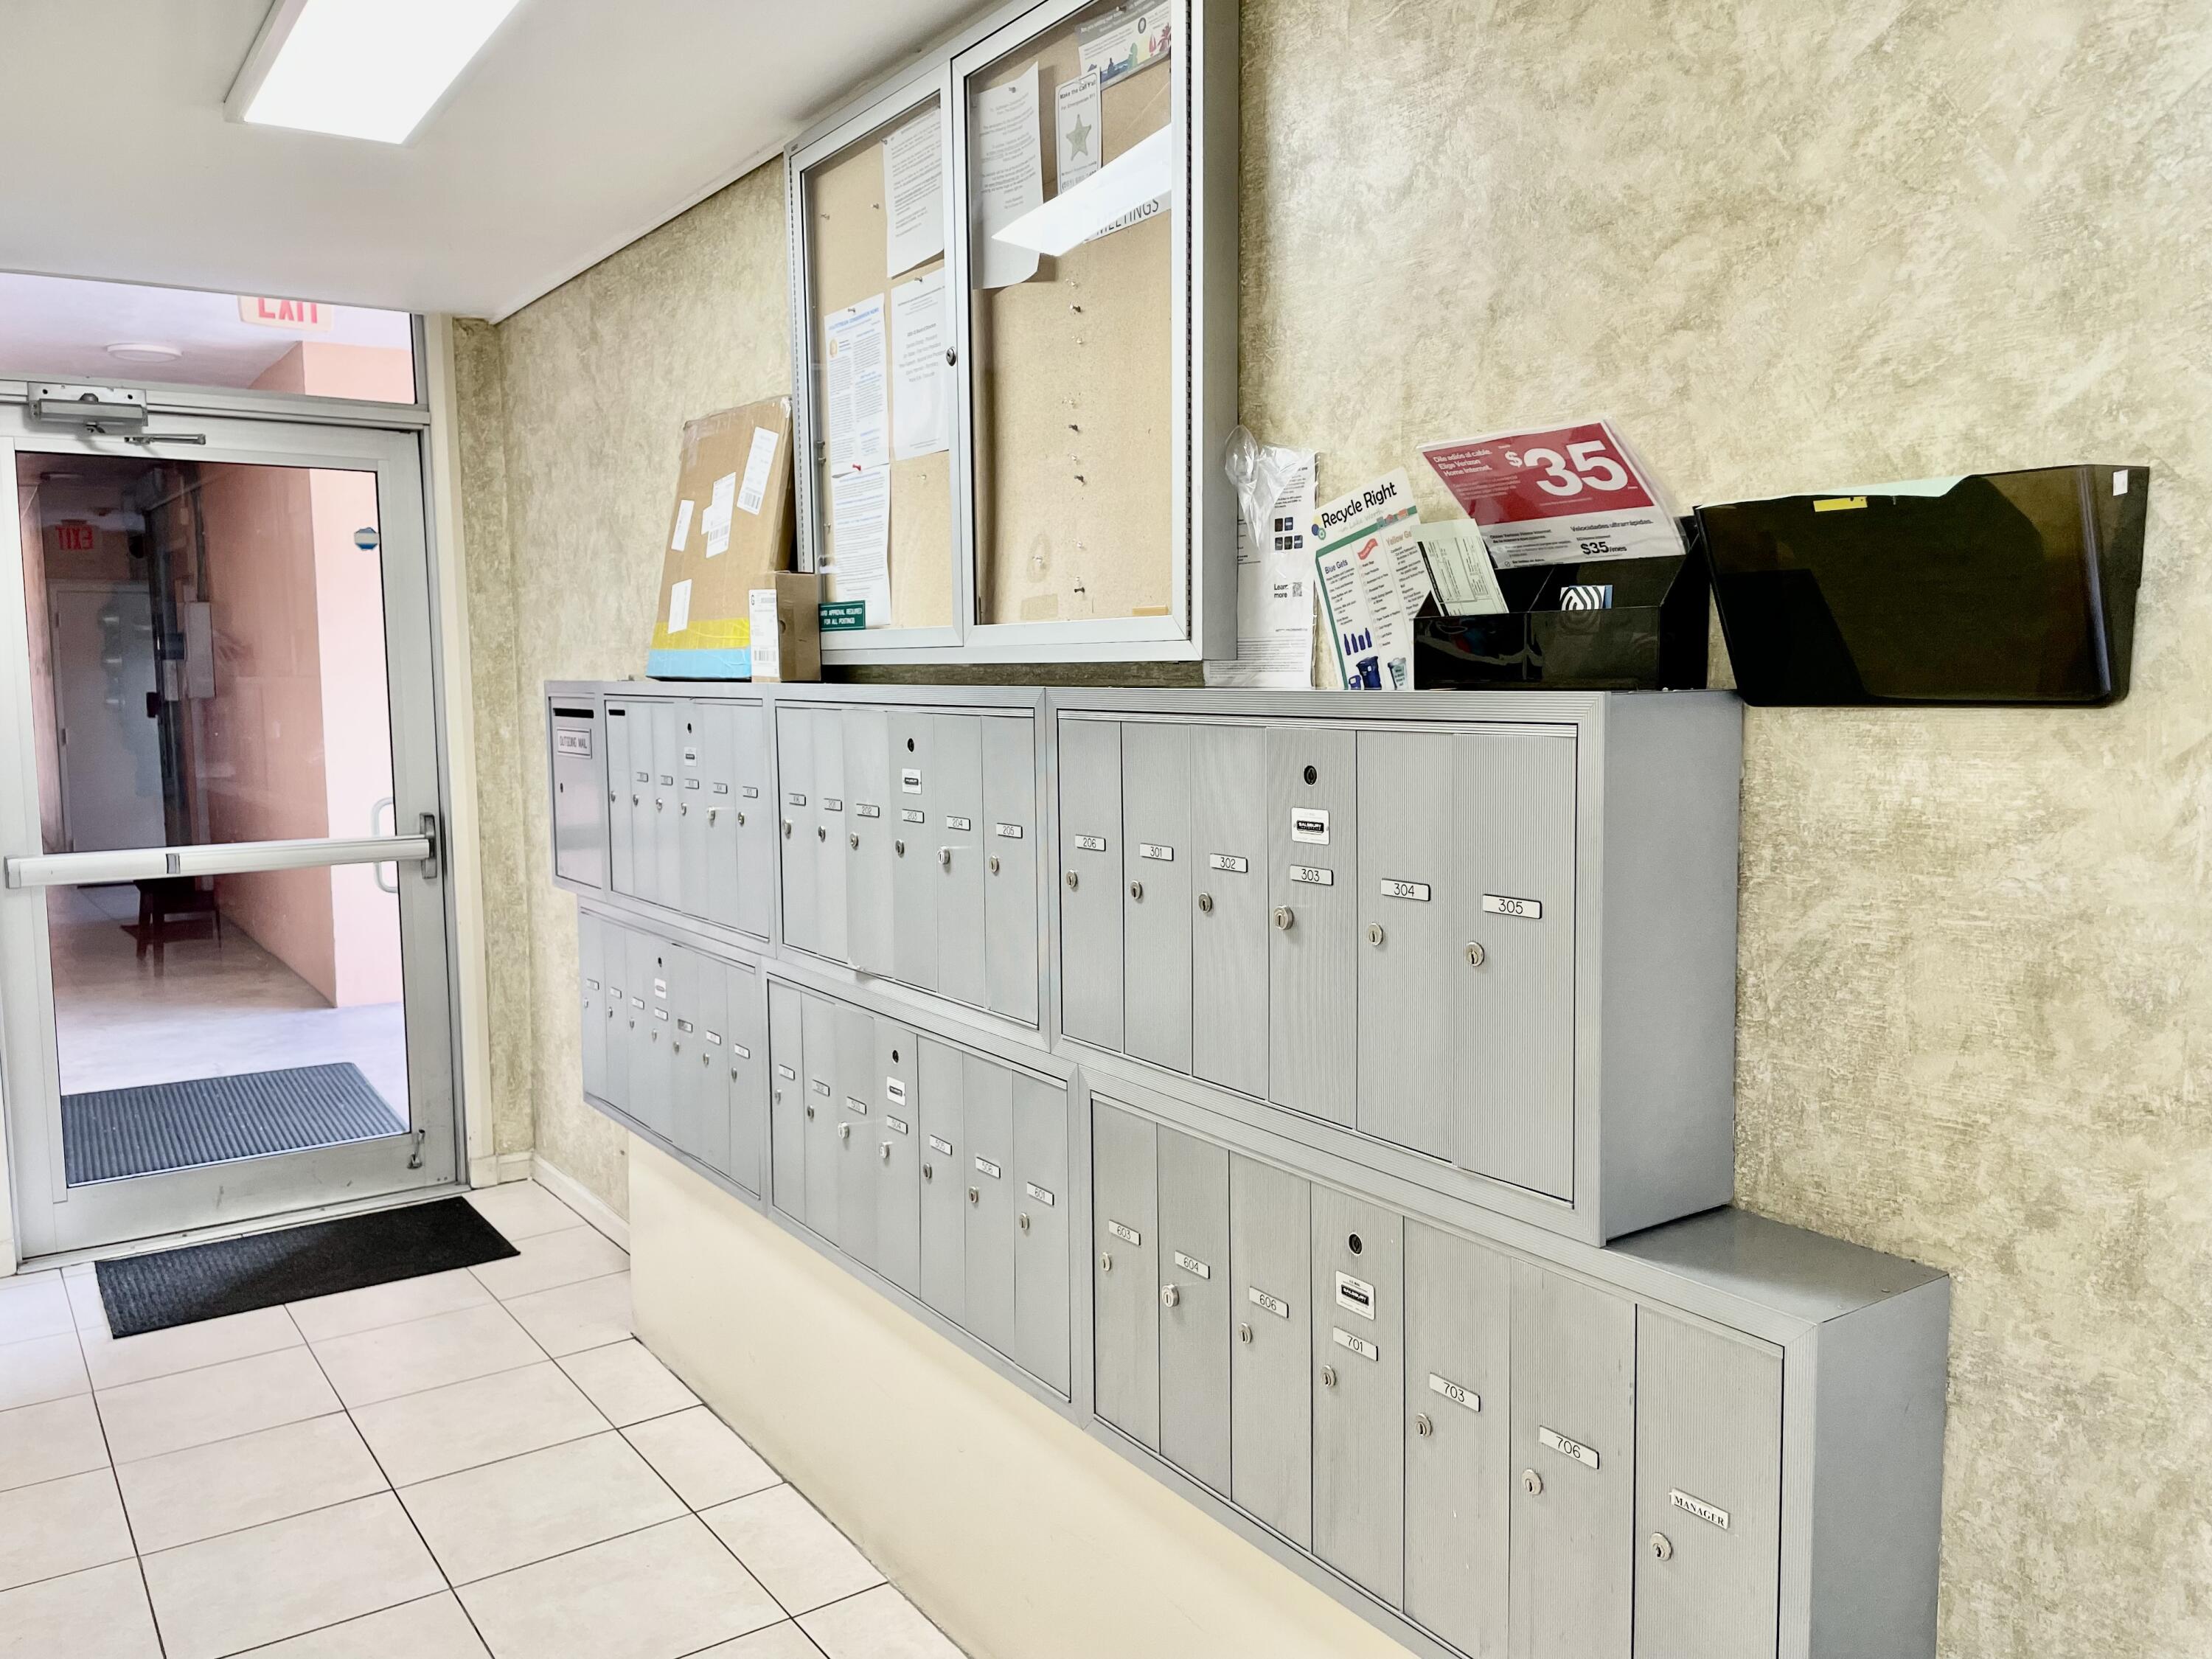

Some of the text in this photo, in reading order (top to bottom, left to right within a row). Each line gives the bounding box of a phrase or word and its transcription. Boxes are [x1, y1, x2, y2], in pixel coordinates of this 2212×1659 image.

[1444, 469, 1464, 477] Home
[1321, 482, 1397, 528] Recycle Right
[1325, 560, 1348, 574] Blue Gets
[578, 739, 588, 749] MAIL
[861, 807, 872, 815] 202
[907, 811, 917, 820] 203
[953, 818, 963, 827] 204
[1003, 826, 1015, 835] 205
[1082, 838, 1096, 849] 206
[1150, 846, 1162, 858] 301
[1220, 858, 1236, 869] 302
[1301, 869, 1320, 882] 303
[1394, 883, 1415, 897] 304
[1498, 899, 1523, 914] 305
[891, 1121, 901, 1130] 504
[935, 1139, 946, 1151] 505
[982, 1161, 993, 1174] 506
[1034, 1188, 1046, 1199] 601
[1116, 1225, 1130, 1240] 603
[1184, 1257, 1198, 1272] 604
[1259, 1294, 1277, 1311] 606
[1347, 1335, 1363, 1352] 701
[1444, 1382, 1465, 1402] 703
[1556, 1436, 1581, 1459] 706
[1674, 1495, 1725, 1527] MANAGER
